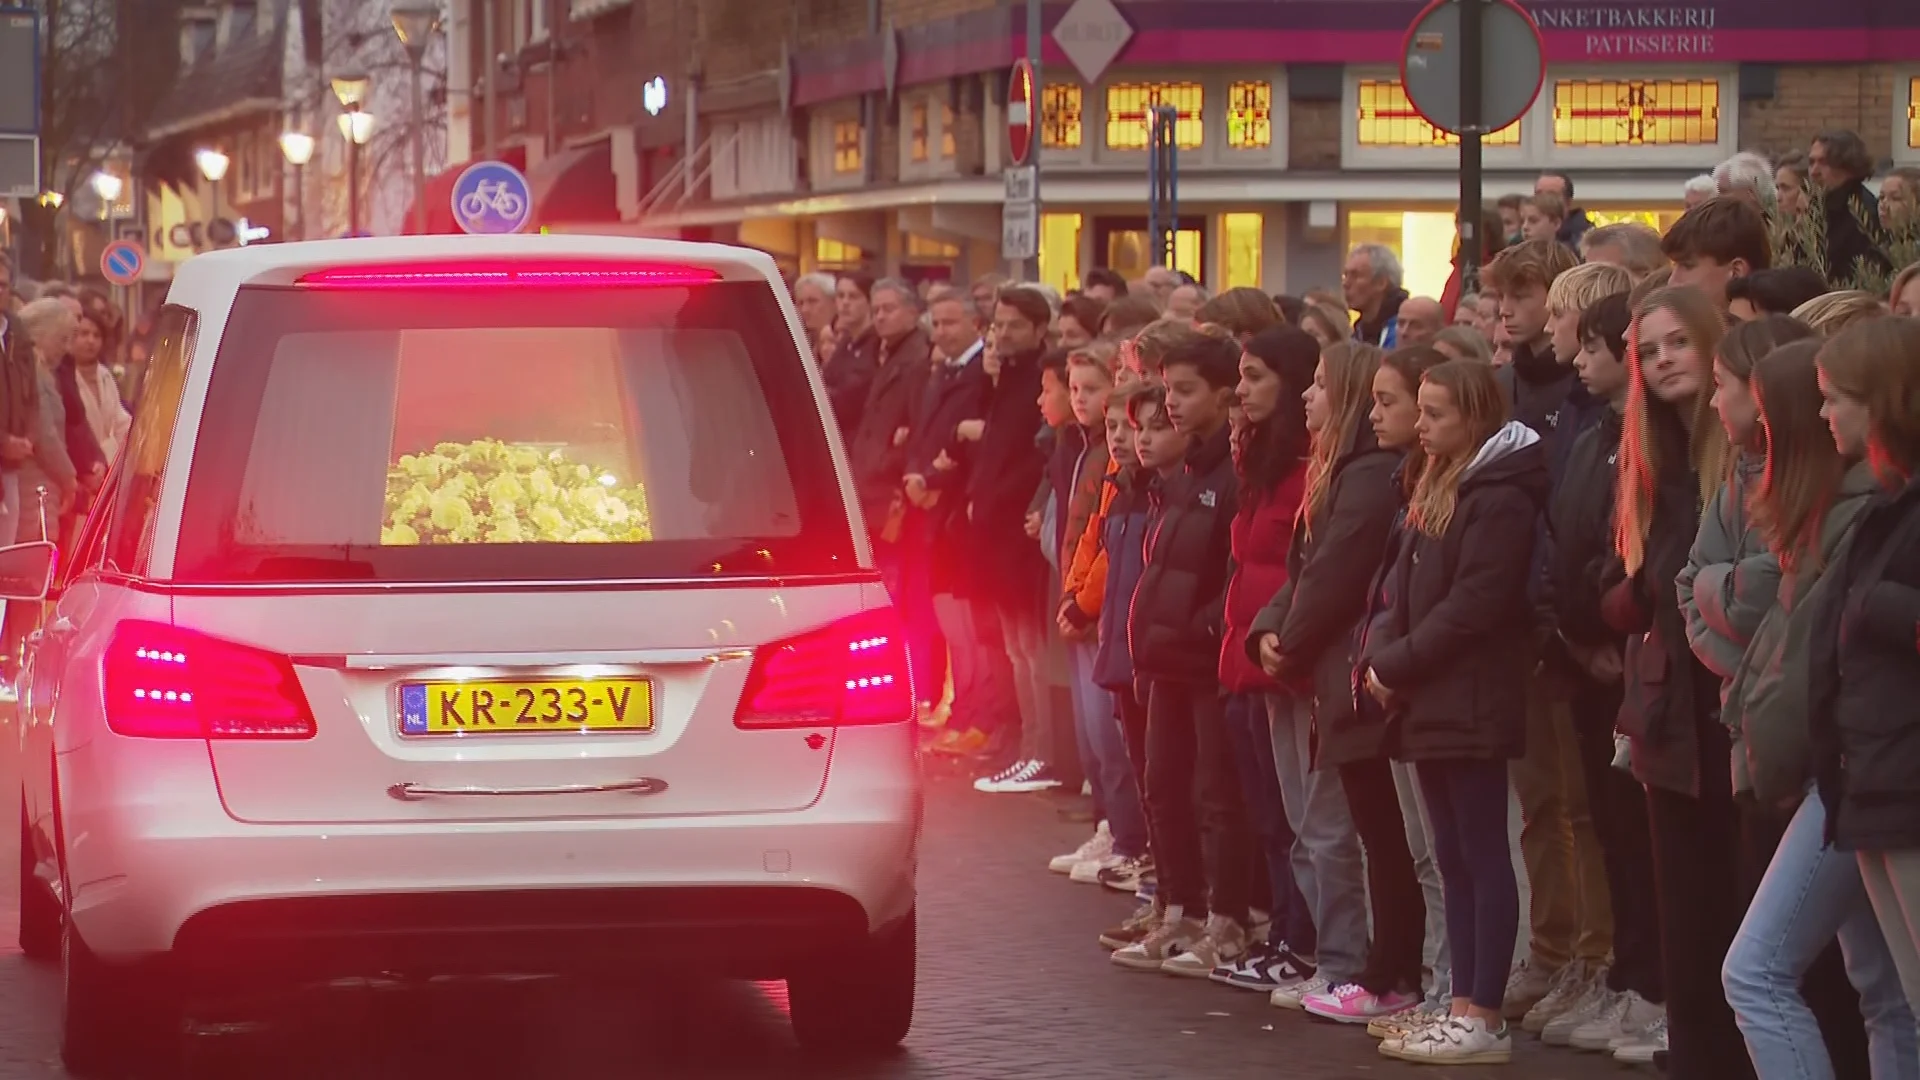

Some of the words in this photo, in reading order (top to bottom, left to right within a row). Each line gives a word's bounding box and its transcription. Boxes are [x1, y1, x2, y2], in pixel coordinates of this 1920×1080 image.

[1586, 35, 1714, 54] PATISSERIE
[440, 687, 632, 725] KR-233-V
[406, 714, 424, 725] NL
